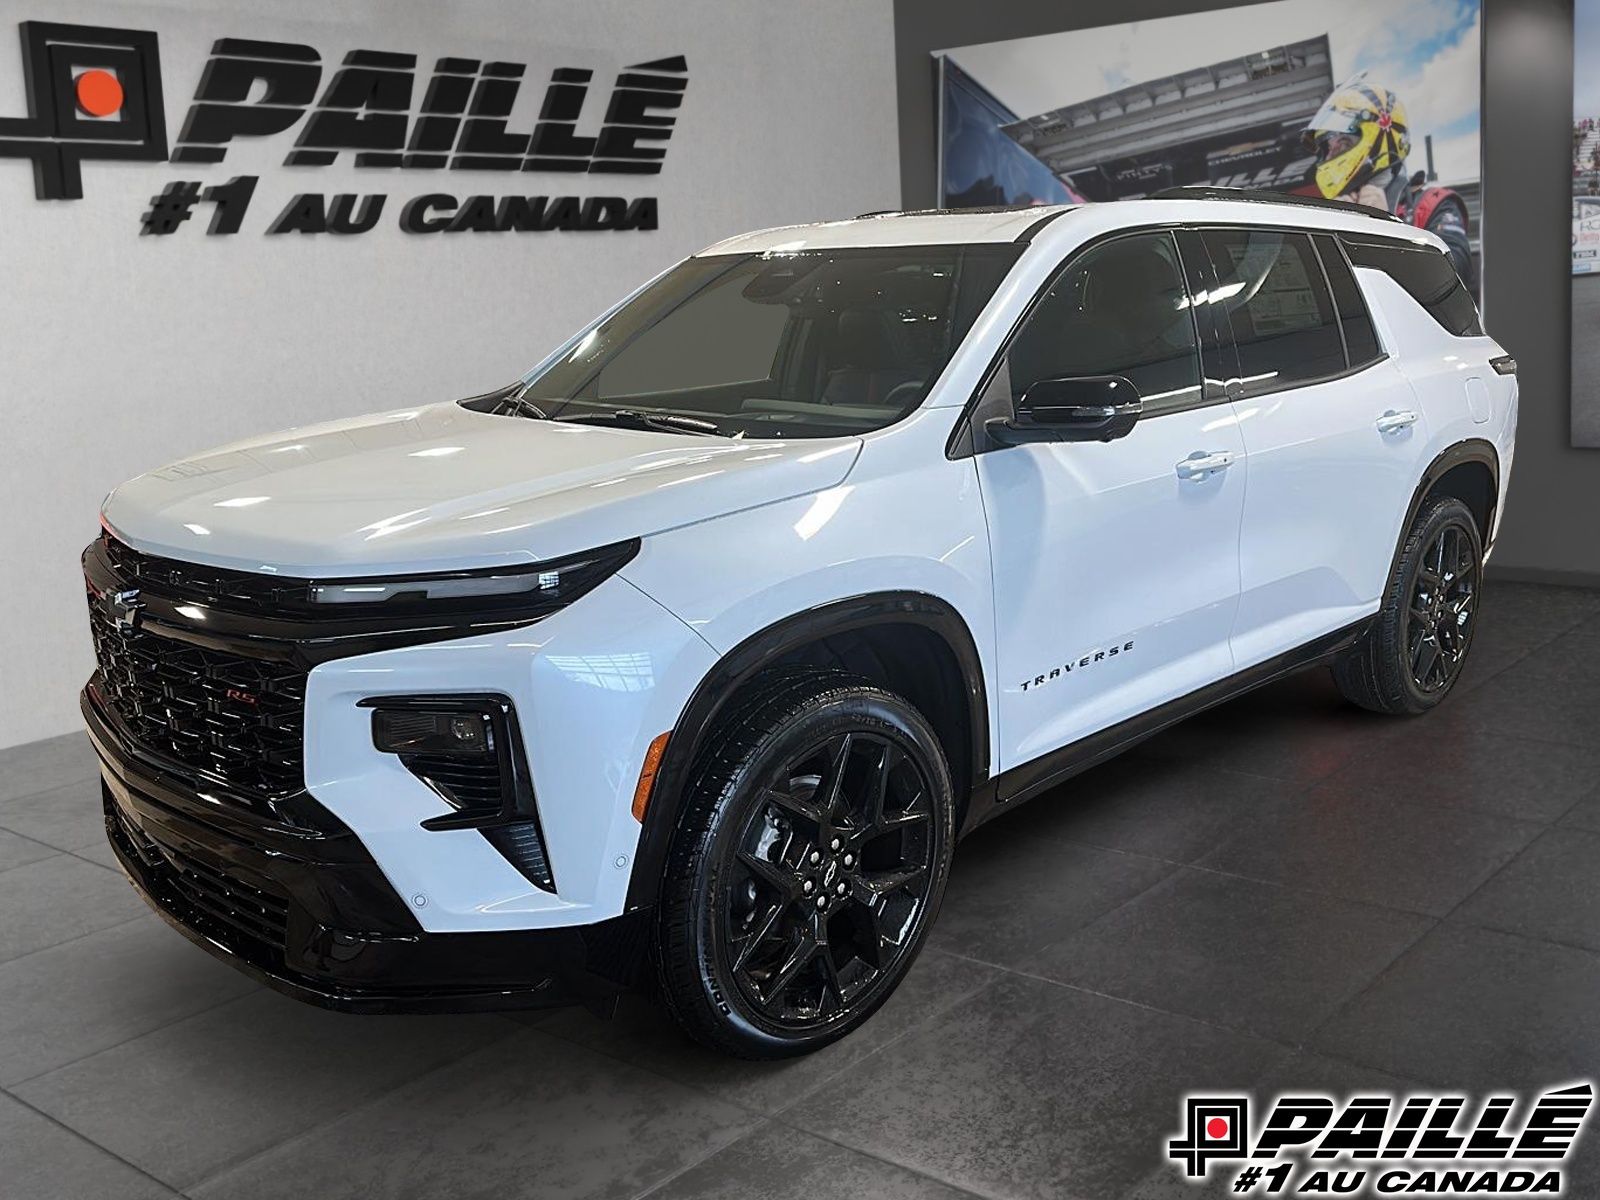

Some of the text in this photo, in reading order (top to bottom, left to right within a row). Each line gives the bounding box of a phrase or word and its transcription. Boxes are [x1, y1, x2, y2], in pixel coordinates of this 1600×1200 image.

[169, 38, 689, 176] PAILLÉ
[140, 175, 660, 236] #1 AU CANADA
[1020, 640, 1135, 692] TRAVERSE
[226, 688, 256, 704] RS
